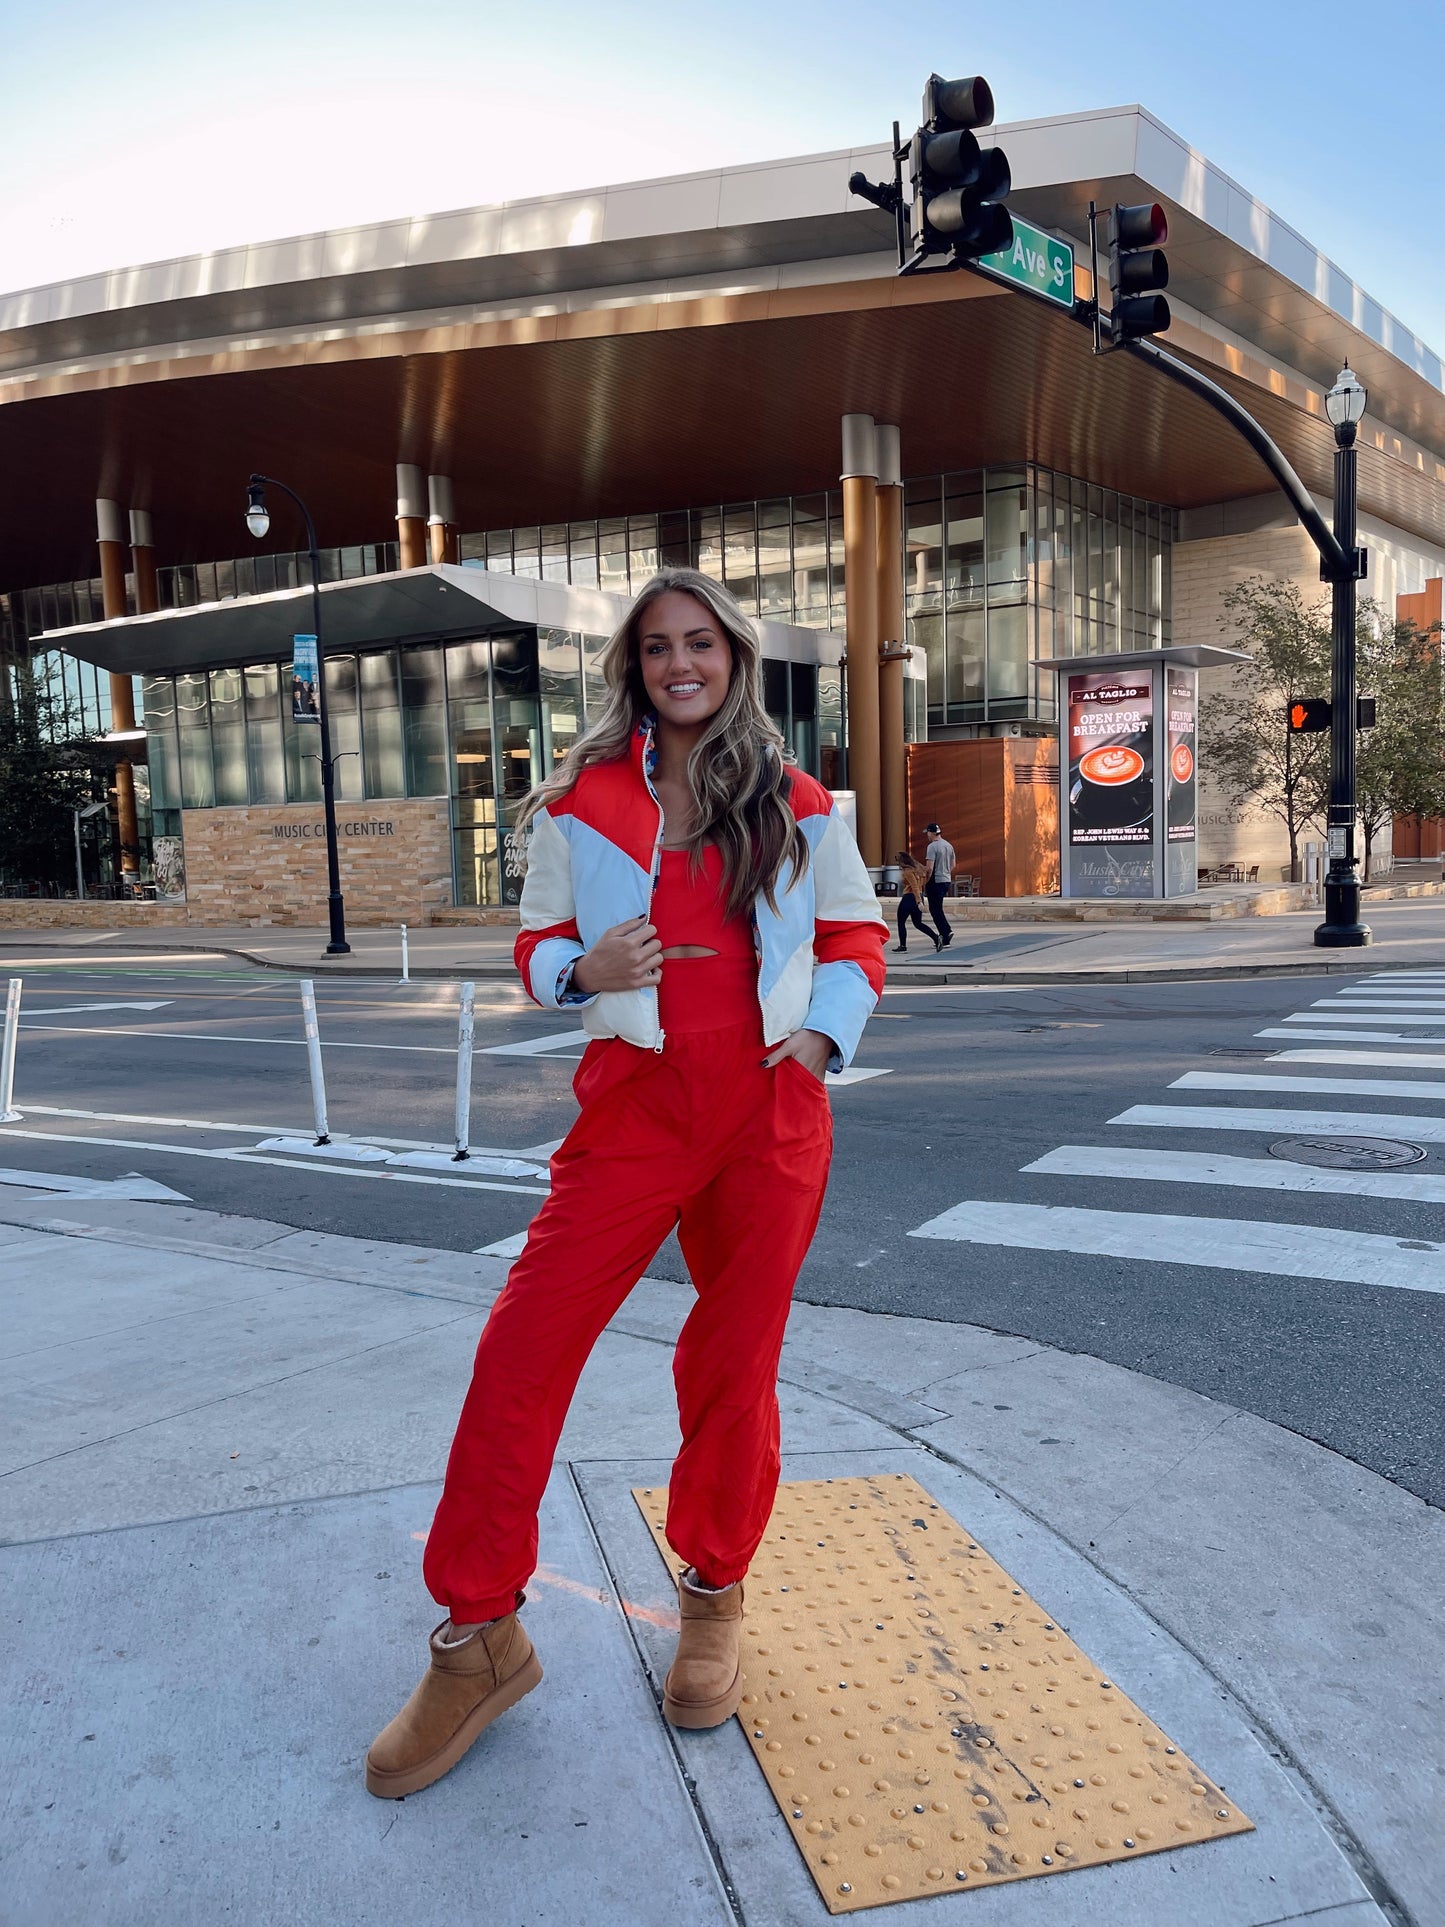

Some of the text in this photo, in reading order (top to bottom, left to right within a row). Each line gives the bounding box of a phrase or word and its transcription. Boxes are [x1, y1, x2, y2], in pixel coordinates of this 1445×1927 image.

[1012, 236, 1065, 287] Ave S
[1082, 689, 1137, 700] AL TAGLIO
[1080, 711, 1141, 725] OPEN FOR
[1073, 721, 1149, 736] BREAKFAST
[1197, 815, 1224, 825] USIC
[274, 822, 394, 838] MUSIC CIY CENTER
[503, 847, 526, 862] AND
[505, 863, 521, 878] GO
